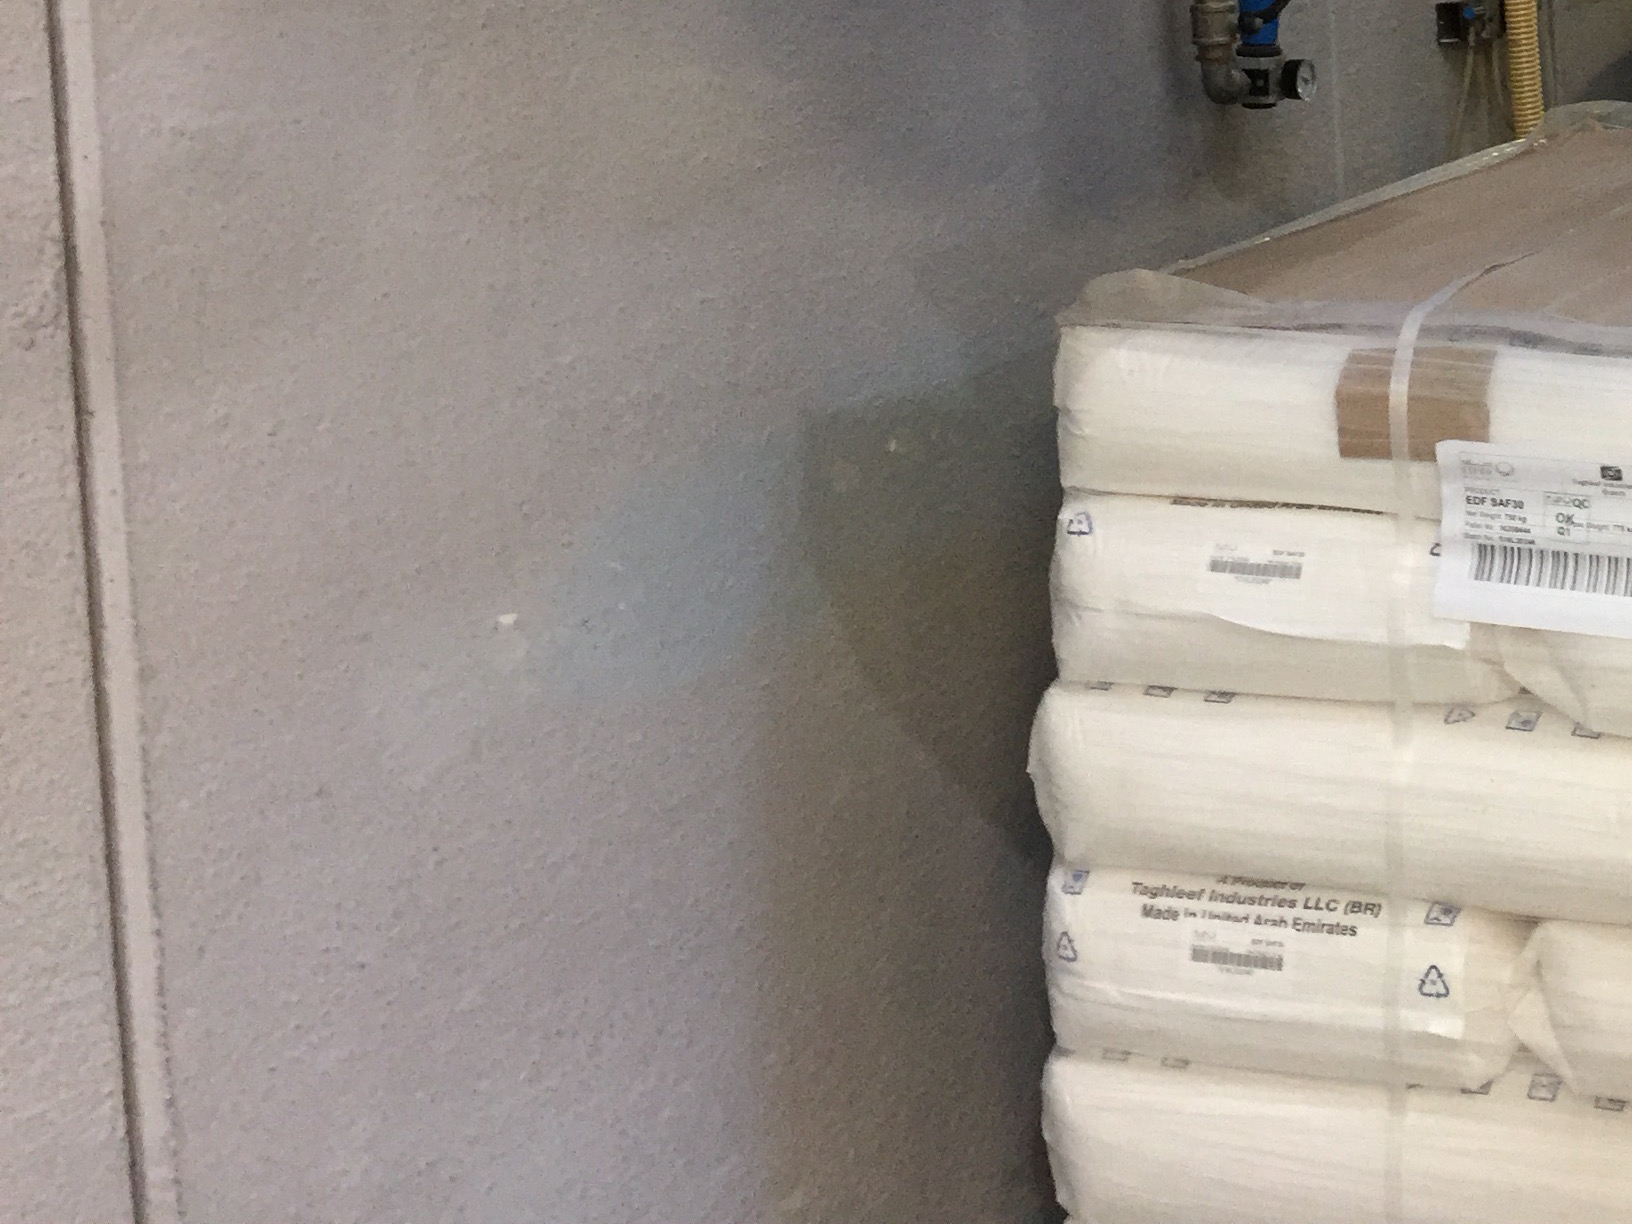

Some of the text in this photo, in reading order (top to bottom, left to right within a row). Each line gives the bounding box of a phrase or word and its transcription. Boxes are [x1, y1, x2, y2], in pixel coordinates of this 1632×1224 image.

[1465, 495, 1487, 506] EDF
[1555, 512, 1575, 525] OK
[1132, 880, 1383, 919] Taghleef Industries LLC (BR)
[1140, 903, 1180, 922] Made
[1290, 917, 1358, 937] Emirates
